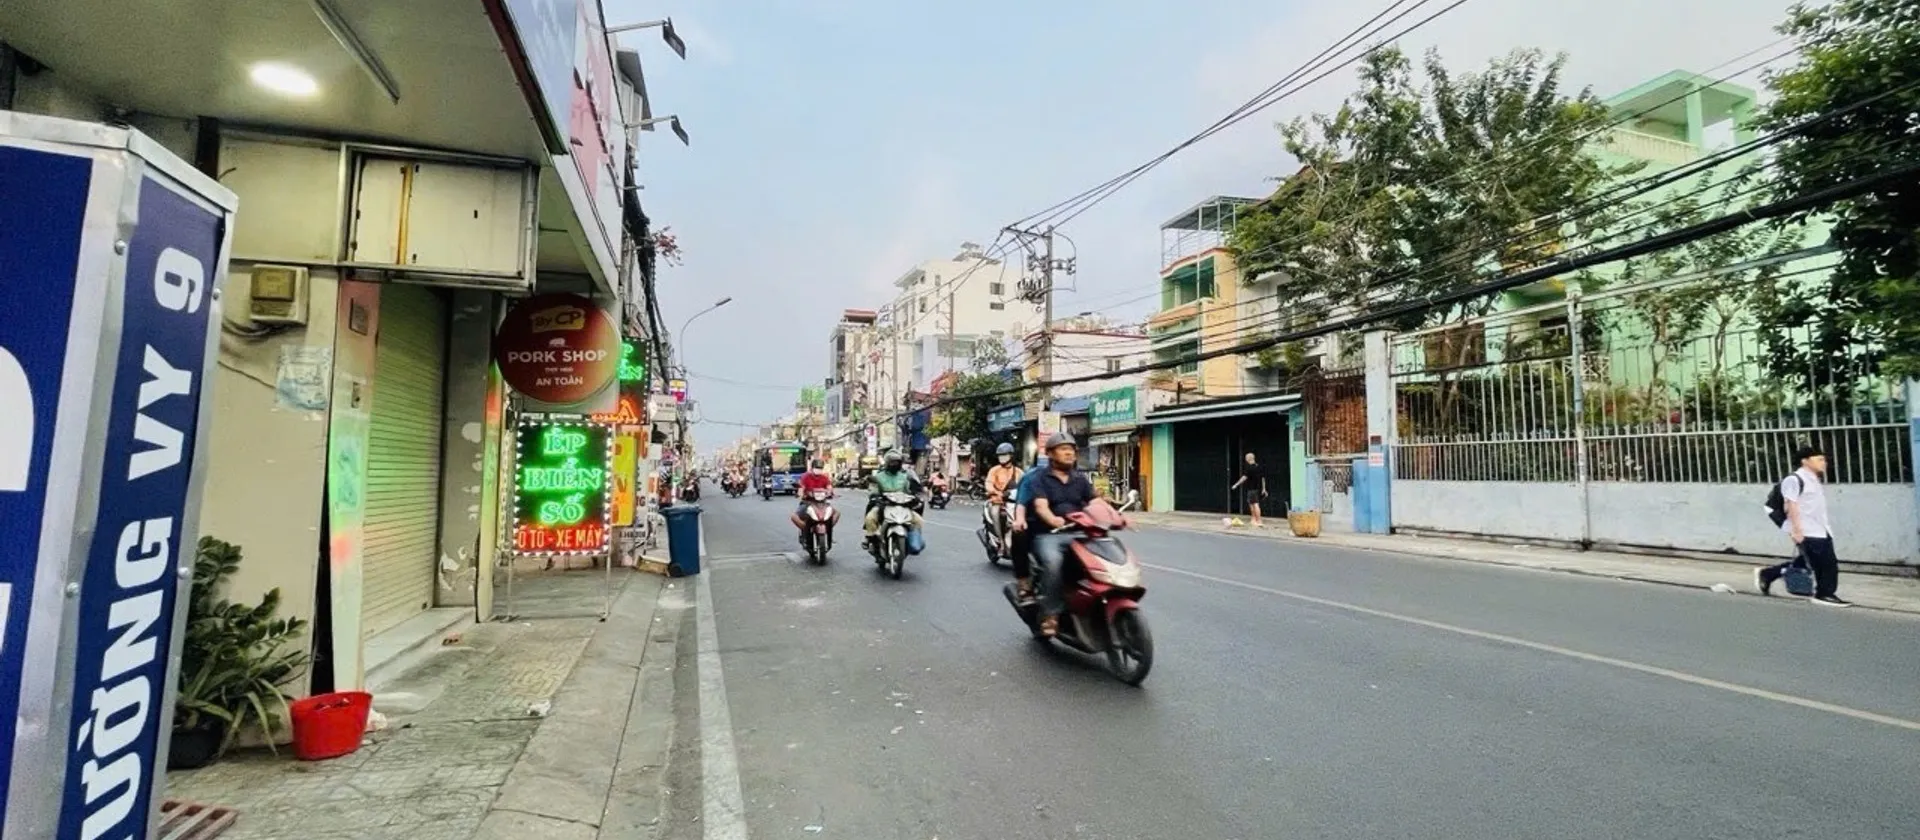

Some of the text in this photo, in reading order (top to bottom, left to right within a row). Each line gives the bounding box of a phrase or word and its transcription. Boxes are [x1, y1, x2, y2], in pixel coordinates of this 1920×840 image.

[556, 311, 582, 325] CP
[508, 349, 608, 363] PORK SHOP
[536, 375, 583, 386] AN TOÀN
[523, 457, 603, 491] BIỂN
[540, 492, 586, 524] SỐ
[77, 247, 204, 840] ƯỜNG VY 9
[556, 529, 573, 548] XE
[575, 524, 603, 548] MÁY
